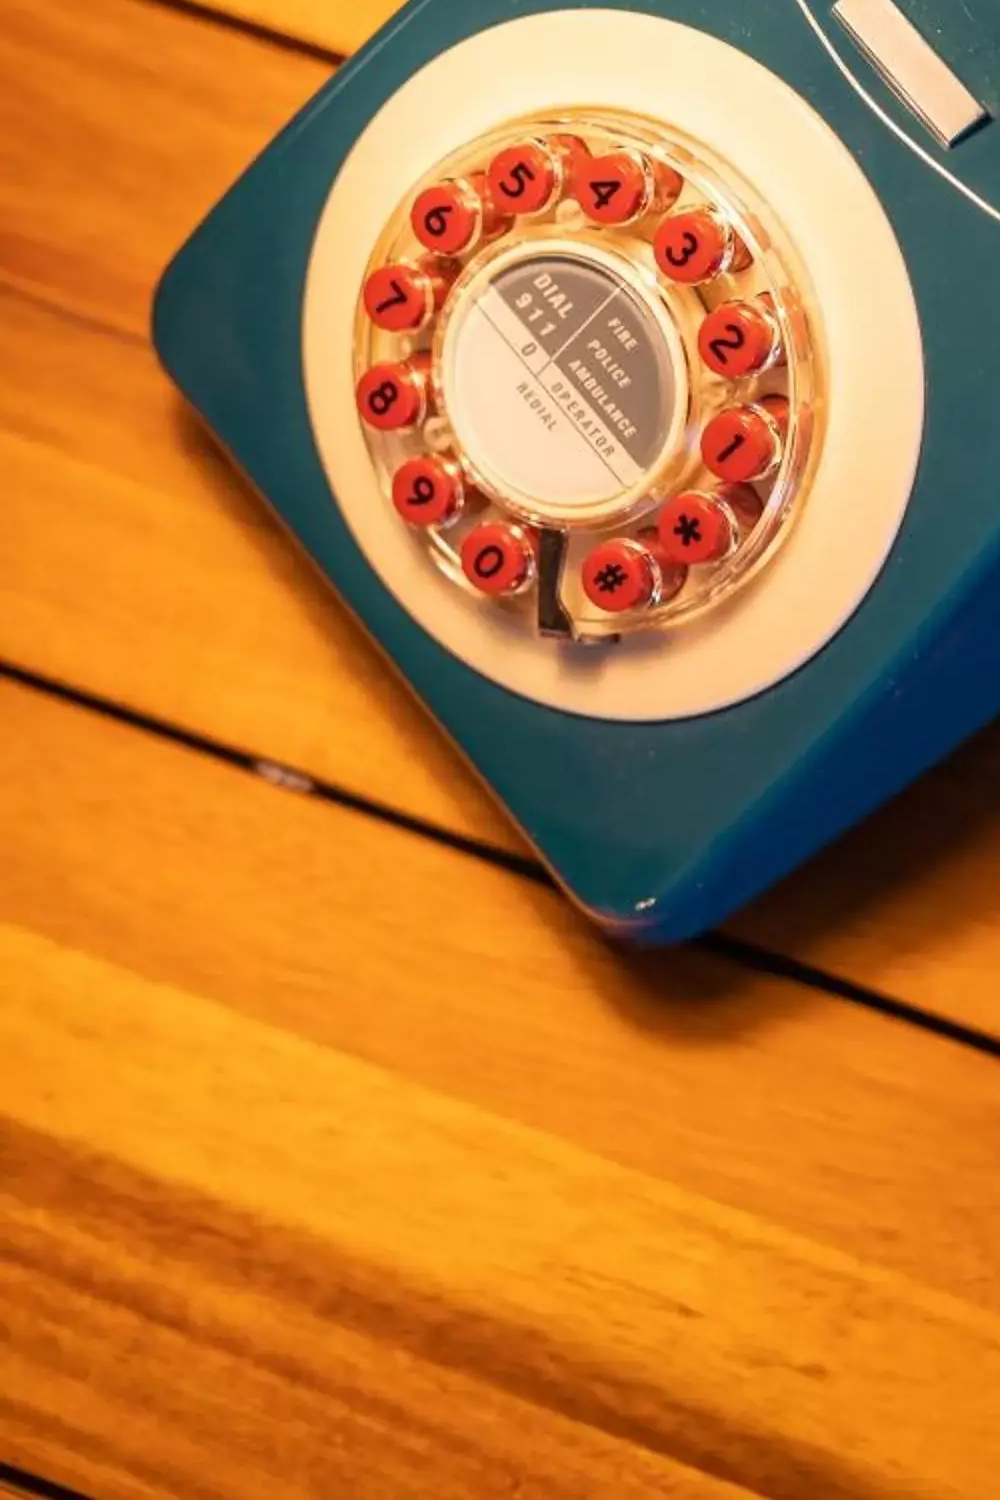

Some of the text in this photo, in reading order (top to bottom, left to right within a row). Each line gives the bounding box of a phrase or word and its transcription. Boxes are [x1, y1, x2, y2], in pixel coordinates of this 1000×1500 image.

[500, 164, 533, 197] 5
[591, 181, 620, 208] 4
[425, 206, 451, 236] 6
[666, 233, 697, 266] 3
[376, 282, 407, 312] 7
[533, 273, 574, 319] DIAL
[608, 317, 638, 351] FIRE
[710, 325, 744, 363] 2
[587, 339, 632, 389] POLICE
[369, 381, 397, 413] 8
[516, 382, 557, 432] REDIAL
[568, 360, 636, 438] AMBULANCE
[551, 381, 615, 458] OPERATOR
[717, 435, 744, 462] 1
[408, 477, 434, 505] 9
